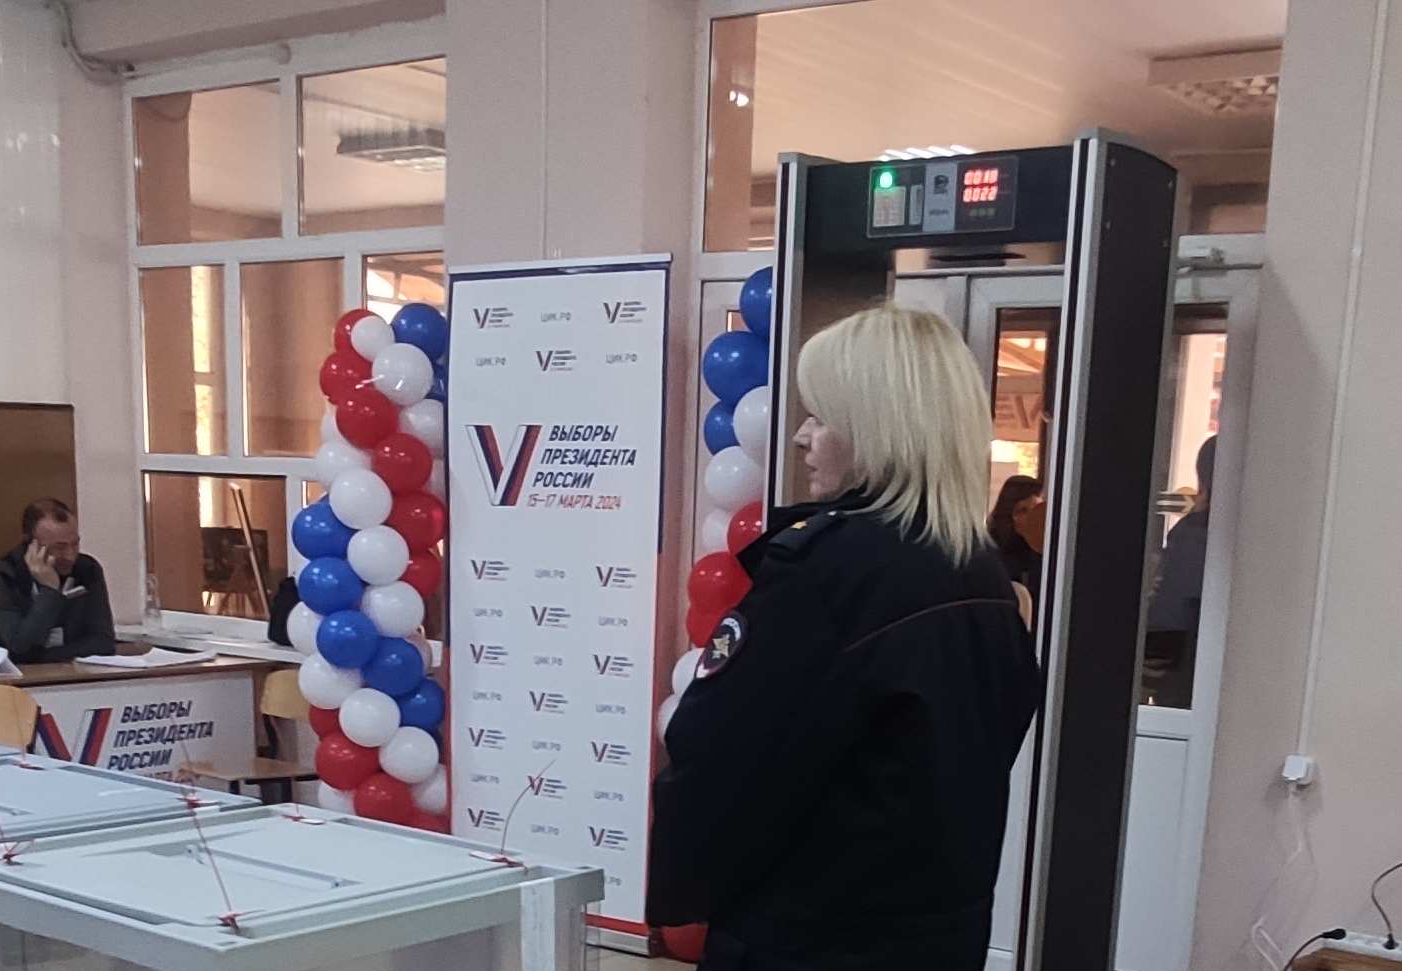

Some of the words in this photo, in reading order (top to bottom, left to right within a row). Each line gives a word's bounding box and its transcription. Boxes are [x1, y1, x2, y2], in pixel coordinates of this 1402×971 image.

[548, 425, 618, 442] ВЫБОРЫ
[540, 448, 637, 468] ПРЕЗИДЕНТА
[532, 471, 595, 488] РОССИИ
[557, 494, 594, 508] МАРТА
[594, 495, 622, 510] 2024
[121, 701, 192, 724] ВЫБОРЫ
[114, 721, 213, 748] ПРЕЗИДЕНТА
[107, 748, 173, 770] РОССИИ
